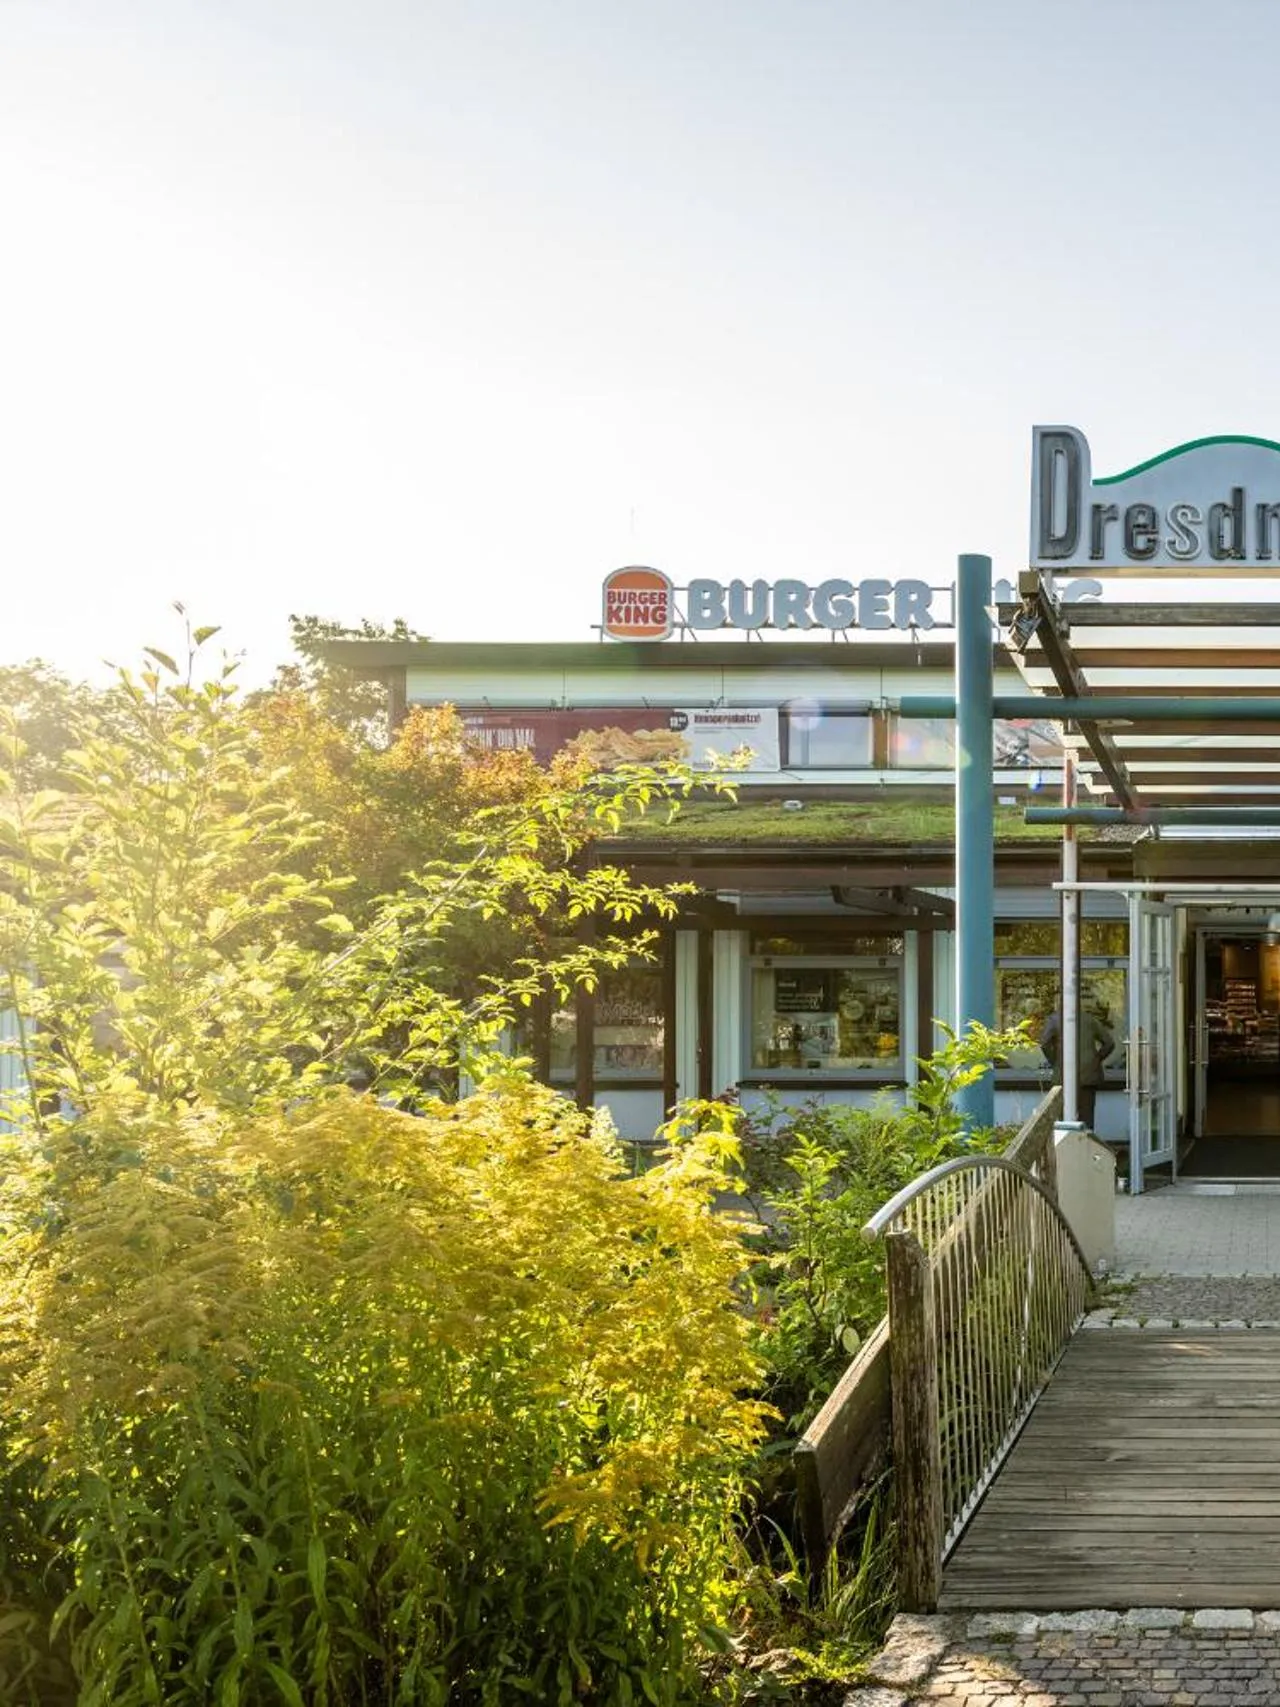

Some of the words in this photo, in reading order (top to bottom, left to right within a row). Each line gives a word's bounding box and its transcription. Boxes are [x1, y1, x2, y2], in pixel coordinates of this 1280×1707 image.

[606, 589, 668, 606] BURGER
[687, 578, 937, 631] BURGER
[606, 605, 668, 626] KING
